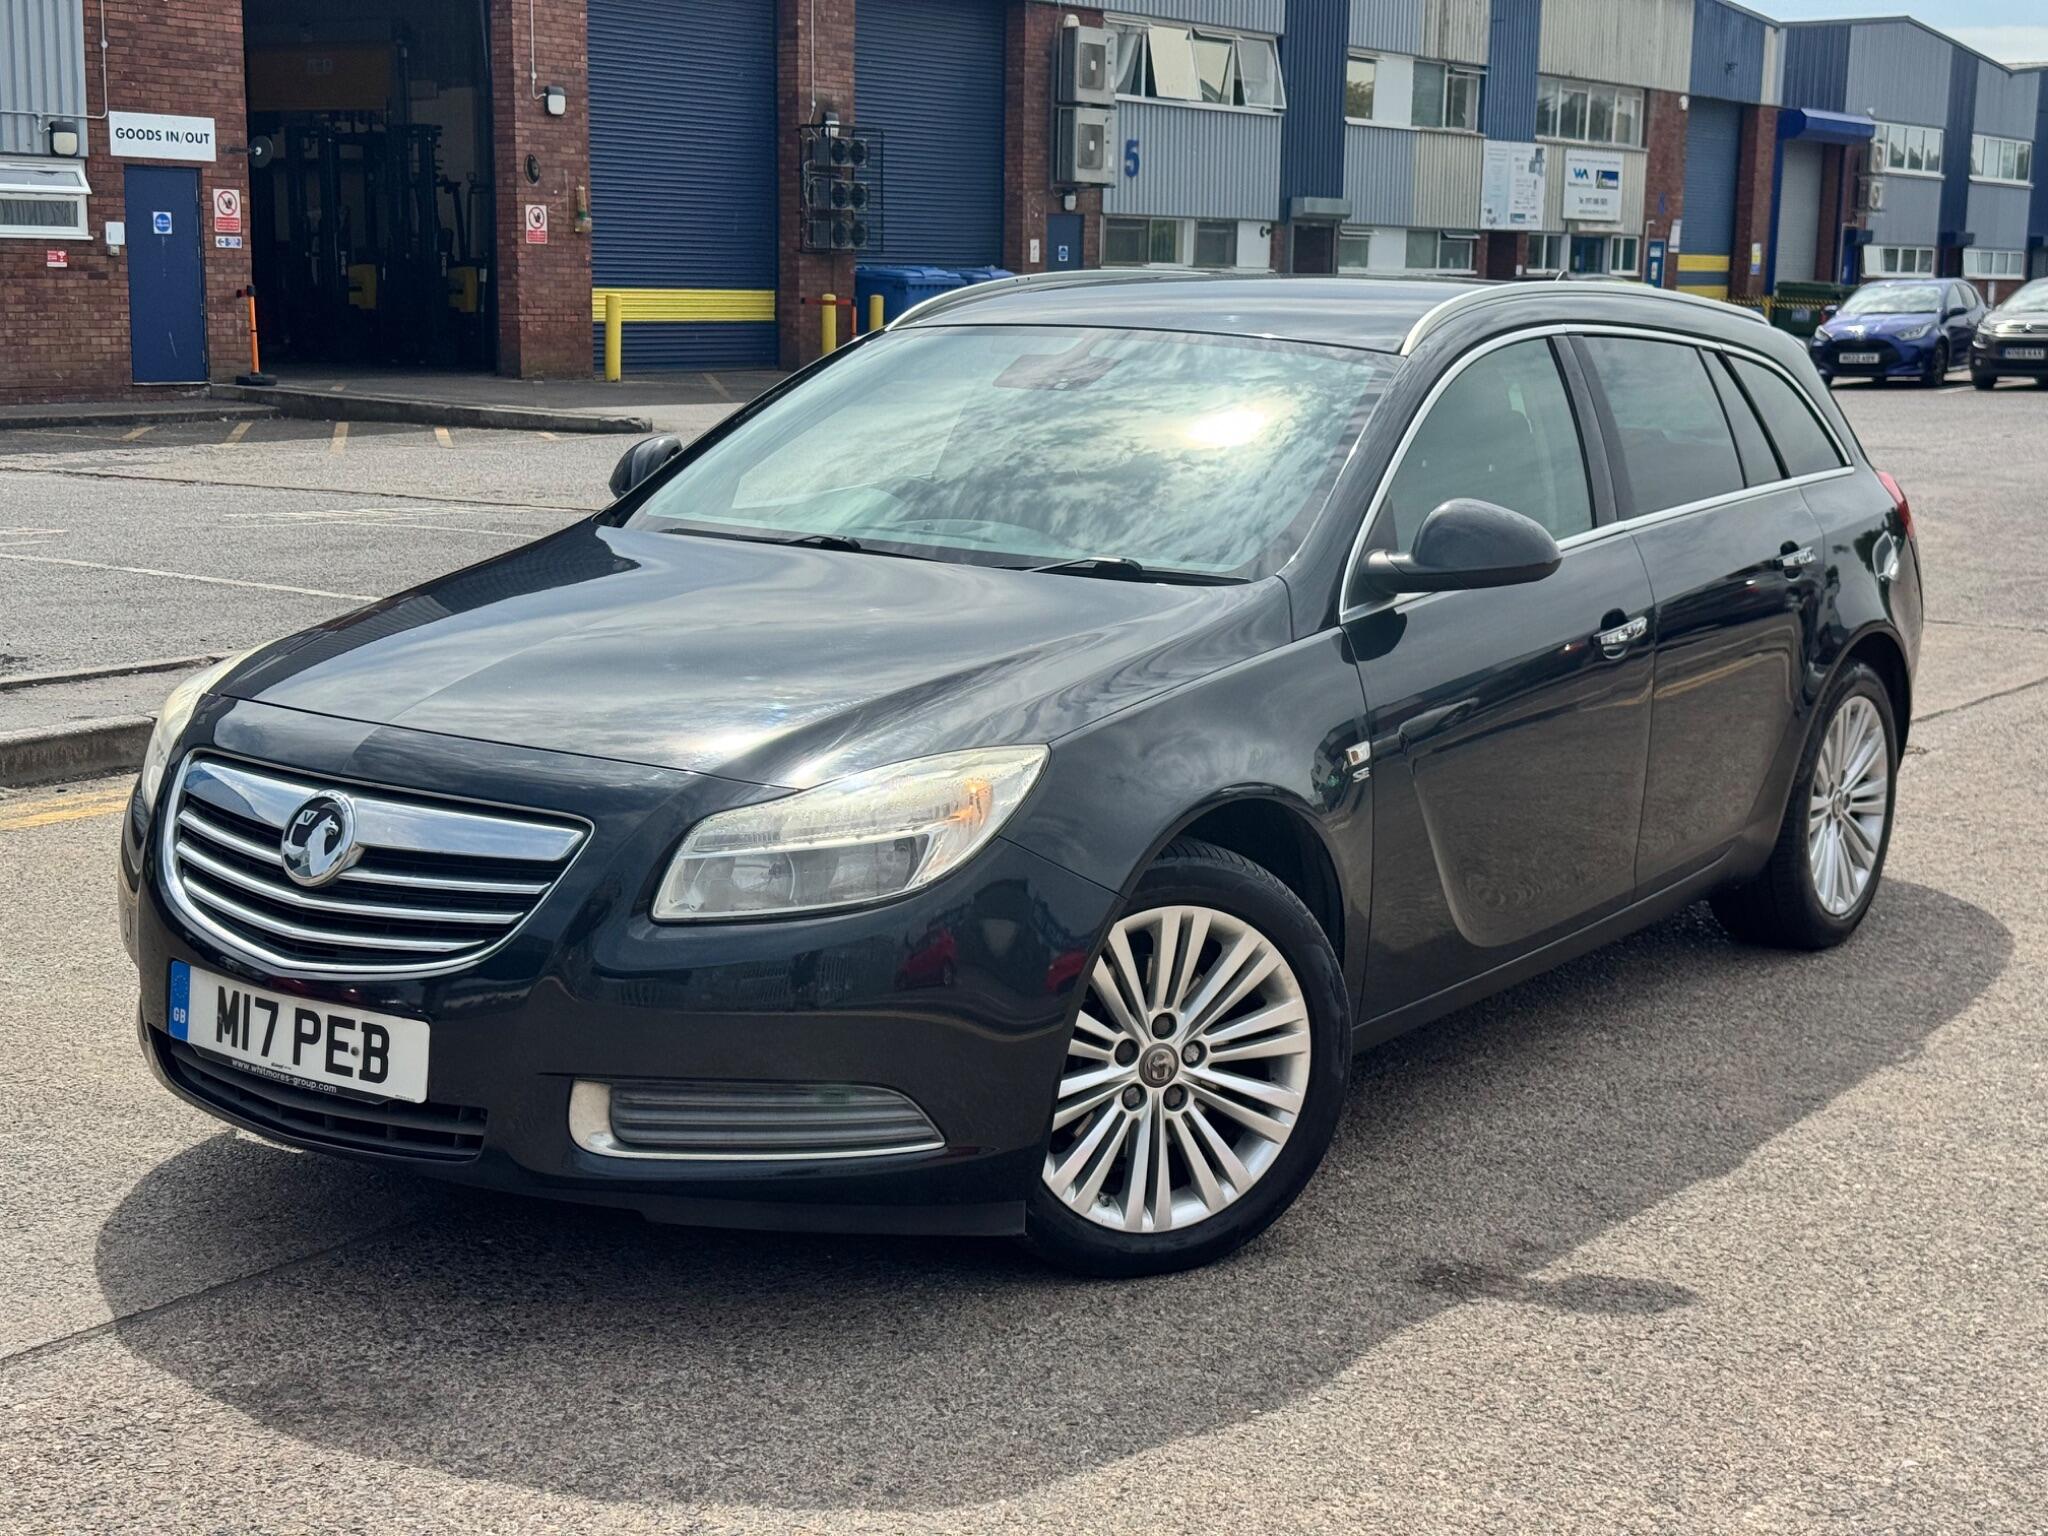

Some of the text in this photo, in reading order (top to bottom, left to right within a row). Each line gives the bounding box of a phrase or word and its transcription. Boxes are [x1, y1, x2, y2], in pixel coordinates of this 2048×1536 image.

[115, 127, 210, 144] GOODS IN/OUT
[1124, 139, 1140, 177] 5
[172, 1007, 186, 1024] GB
[215, 985, 390, 1084] M17 PEB
[231, 1058, 337, 1093] www.whitmores-group.com
